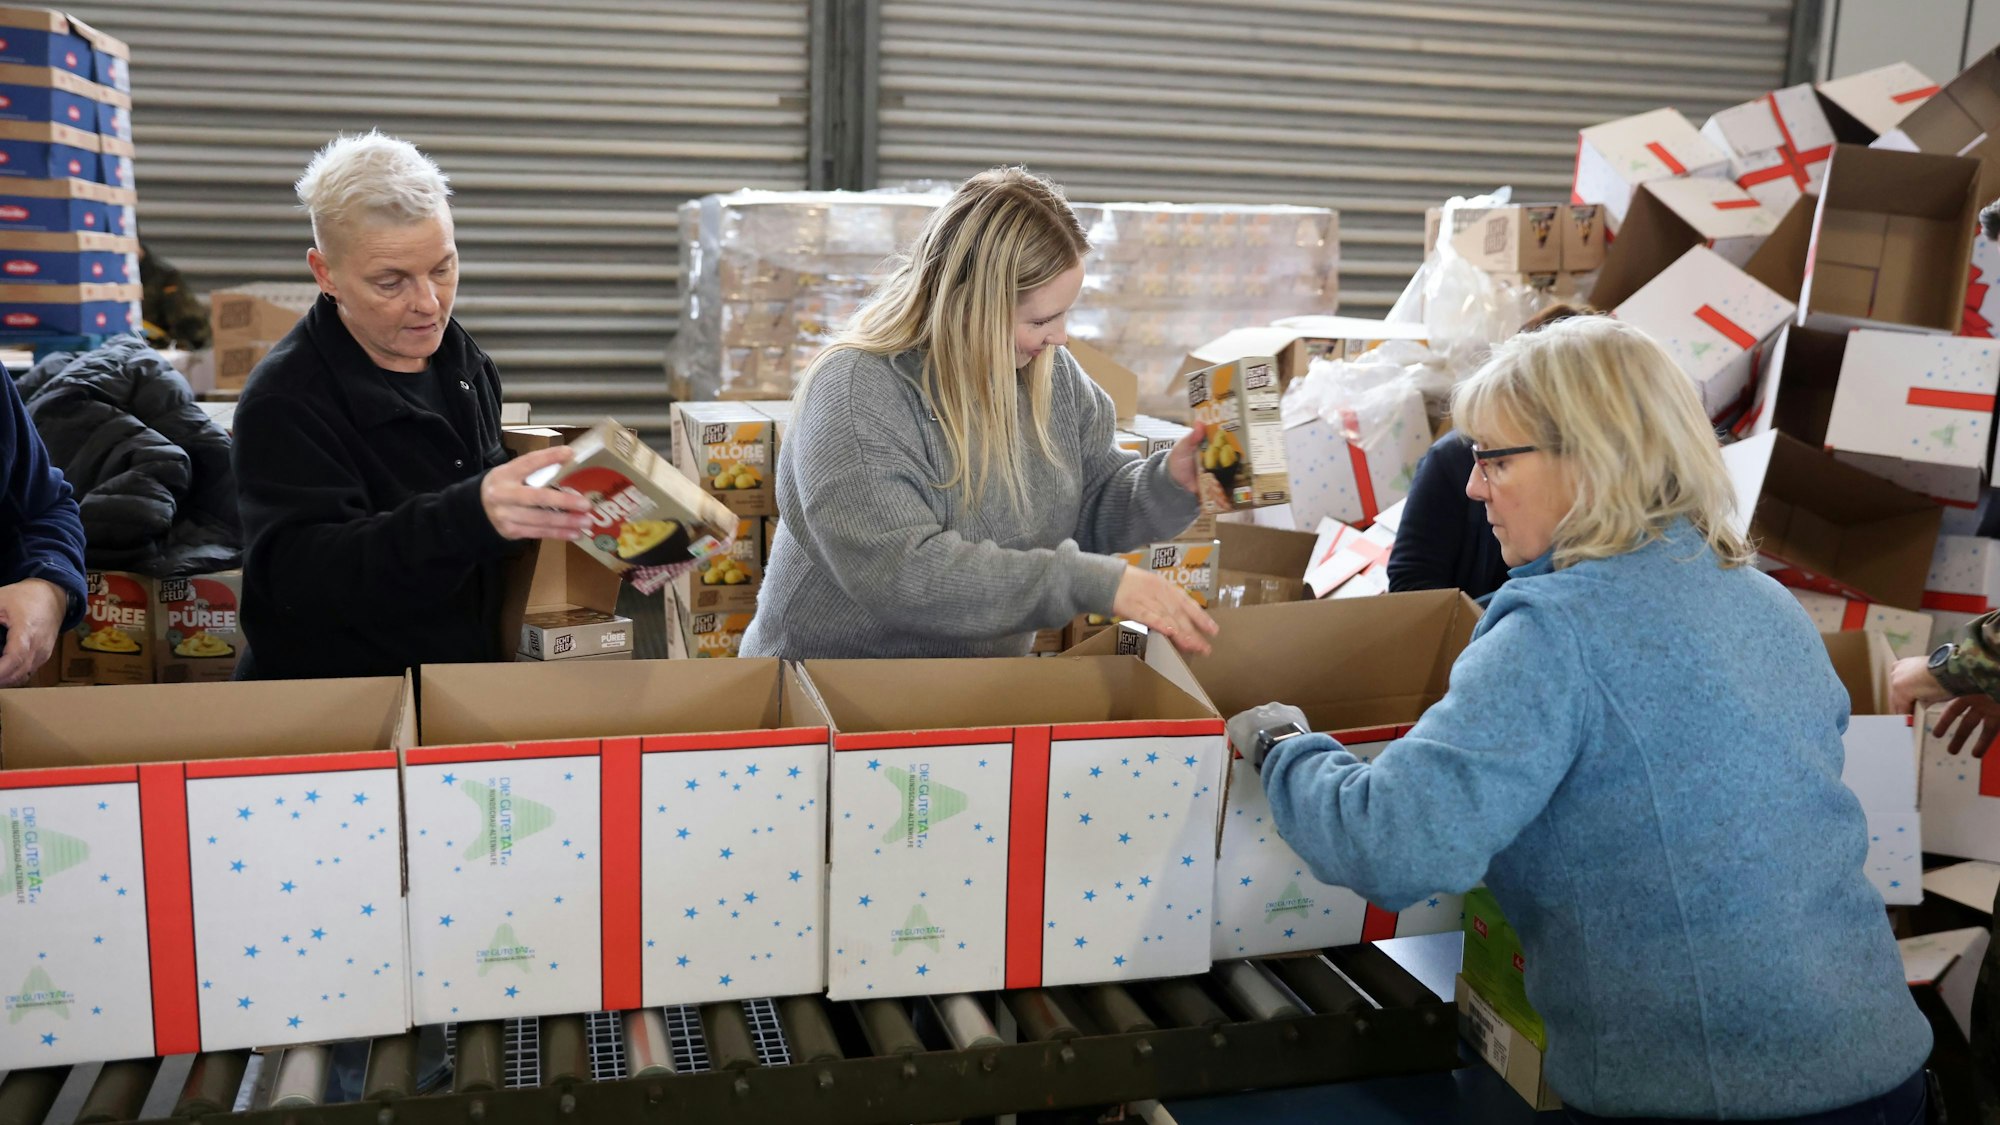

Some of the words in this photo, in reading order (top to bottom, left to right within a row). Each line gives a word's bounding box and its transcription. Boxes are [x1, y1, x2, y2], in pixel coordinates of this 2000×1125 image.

[706, 424, 724, 434] ECHT
[707, 434, 723, 443] FELD
[1156, 548, 1174, 558] ECHT
[1156, 558, 1172, 568] FELD
[163, 579, 185, 592] ECHT
[164, 590, 184, 602] FELD
[168, 606, 236, 627] PÜREE
[556, 636, 570, 646] ECHT
[601, 632, 626, 643] PÜREE
[1122, 633, 1136, 646] ECHT
[556, 644, 569, 653] FELD
[918, 818, 928, 840] TAT
[500, 834, 512, 856] TAT
[27, 870, 44, 894] TAT
